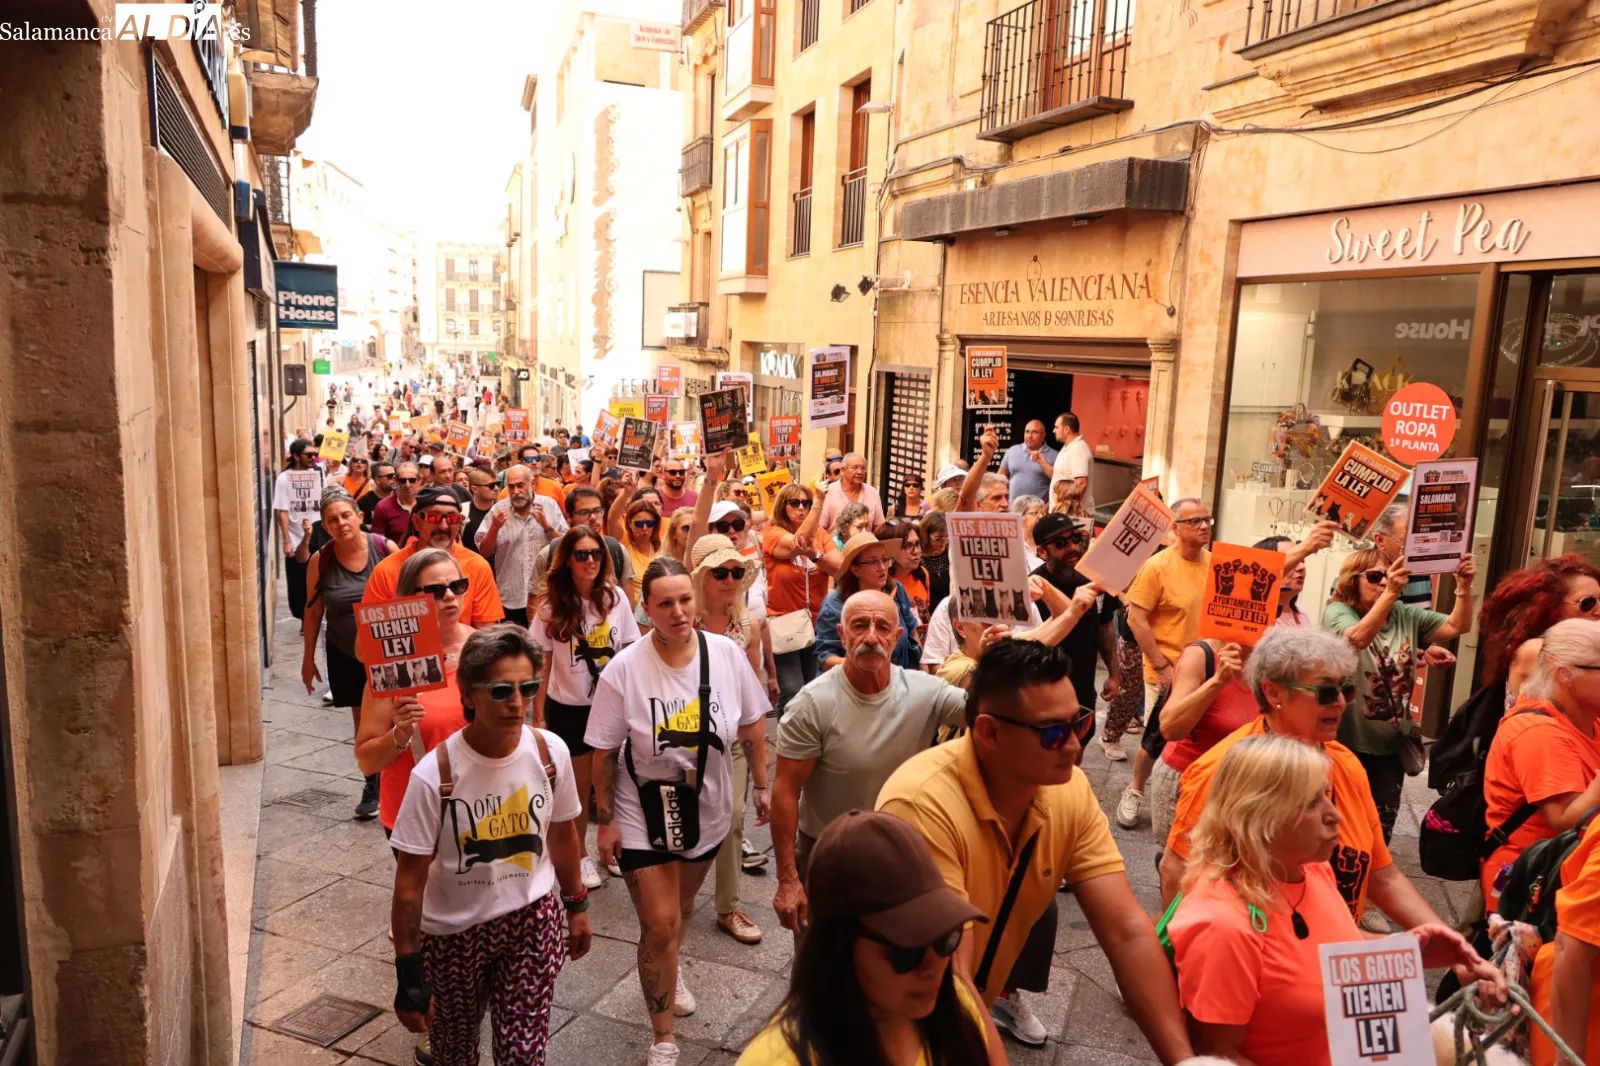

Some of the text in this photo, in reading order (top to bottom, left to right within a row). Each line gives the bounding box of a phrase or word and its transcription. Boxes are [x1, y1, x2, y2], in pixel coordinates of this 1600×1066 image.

[1326, 203, 1532, 264] Sweet Pea
[278, 290, 336, 307] Phone
[960, 272, 1151, 305] ESENCIA VALENCIANA
[279, 306, 336, 321] House
[982, 310, 1041, 327] ARTESANOS
[1054, 309, 1115, 327] SONRISAS
[971, 358, 1002, 367] CUMPLID
[971, 369, 993, 377] LA LEY
[1390, 401, 1450, 420] OUTLET
[778, 433, 789, 443] LEY
[1396, 420, 1436, 438] ROPA
[1402, 439, 1439, 452] PLANTA
[1351, 449, 1401, 480] AYUNTAMIENTOS
[1334, 471, 1351, 487] LA
[1348, 480, 1371, 498] LEY
[1343, 458, 1394, 493] CUMPLID
[297, 489, 310, 498] LEY
[1420, 493, 1456, 504] SALAMANCA
[1130, 491, 1170, 532] LOS GATOS
[952, 520, 1017, 538] LOS GATOS
[1124, 510, 1156, 541] TIENEN
[961, 537, 1007, 556] TIENEN
[1113, 529, 1141, 554] LEY
[973, 558, 1000, 580] LEY
[360, 600, 429, 624] LOS GATOS
[1208, 604, 1268, 624] CUMPLID LA LEY
[1213, 596, 1266, 611] AYUNTAMIENTOS
[371, 617, 419, 638] TIENEN
[383, 636, 411, 658] LEY
[667, 791, 684, 848] adidas
[1330, 951, 1414, 985] LOS GATOS
[1343, 981, 1405, 1015] TIENEN
[1358, 1017, 1394, 1055] LEY
